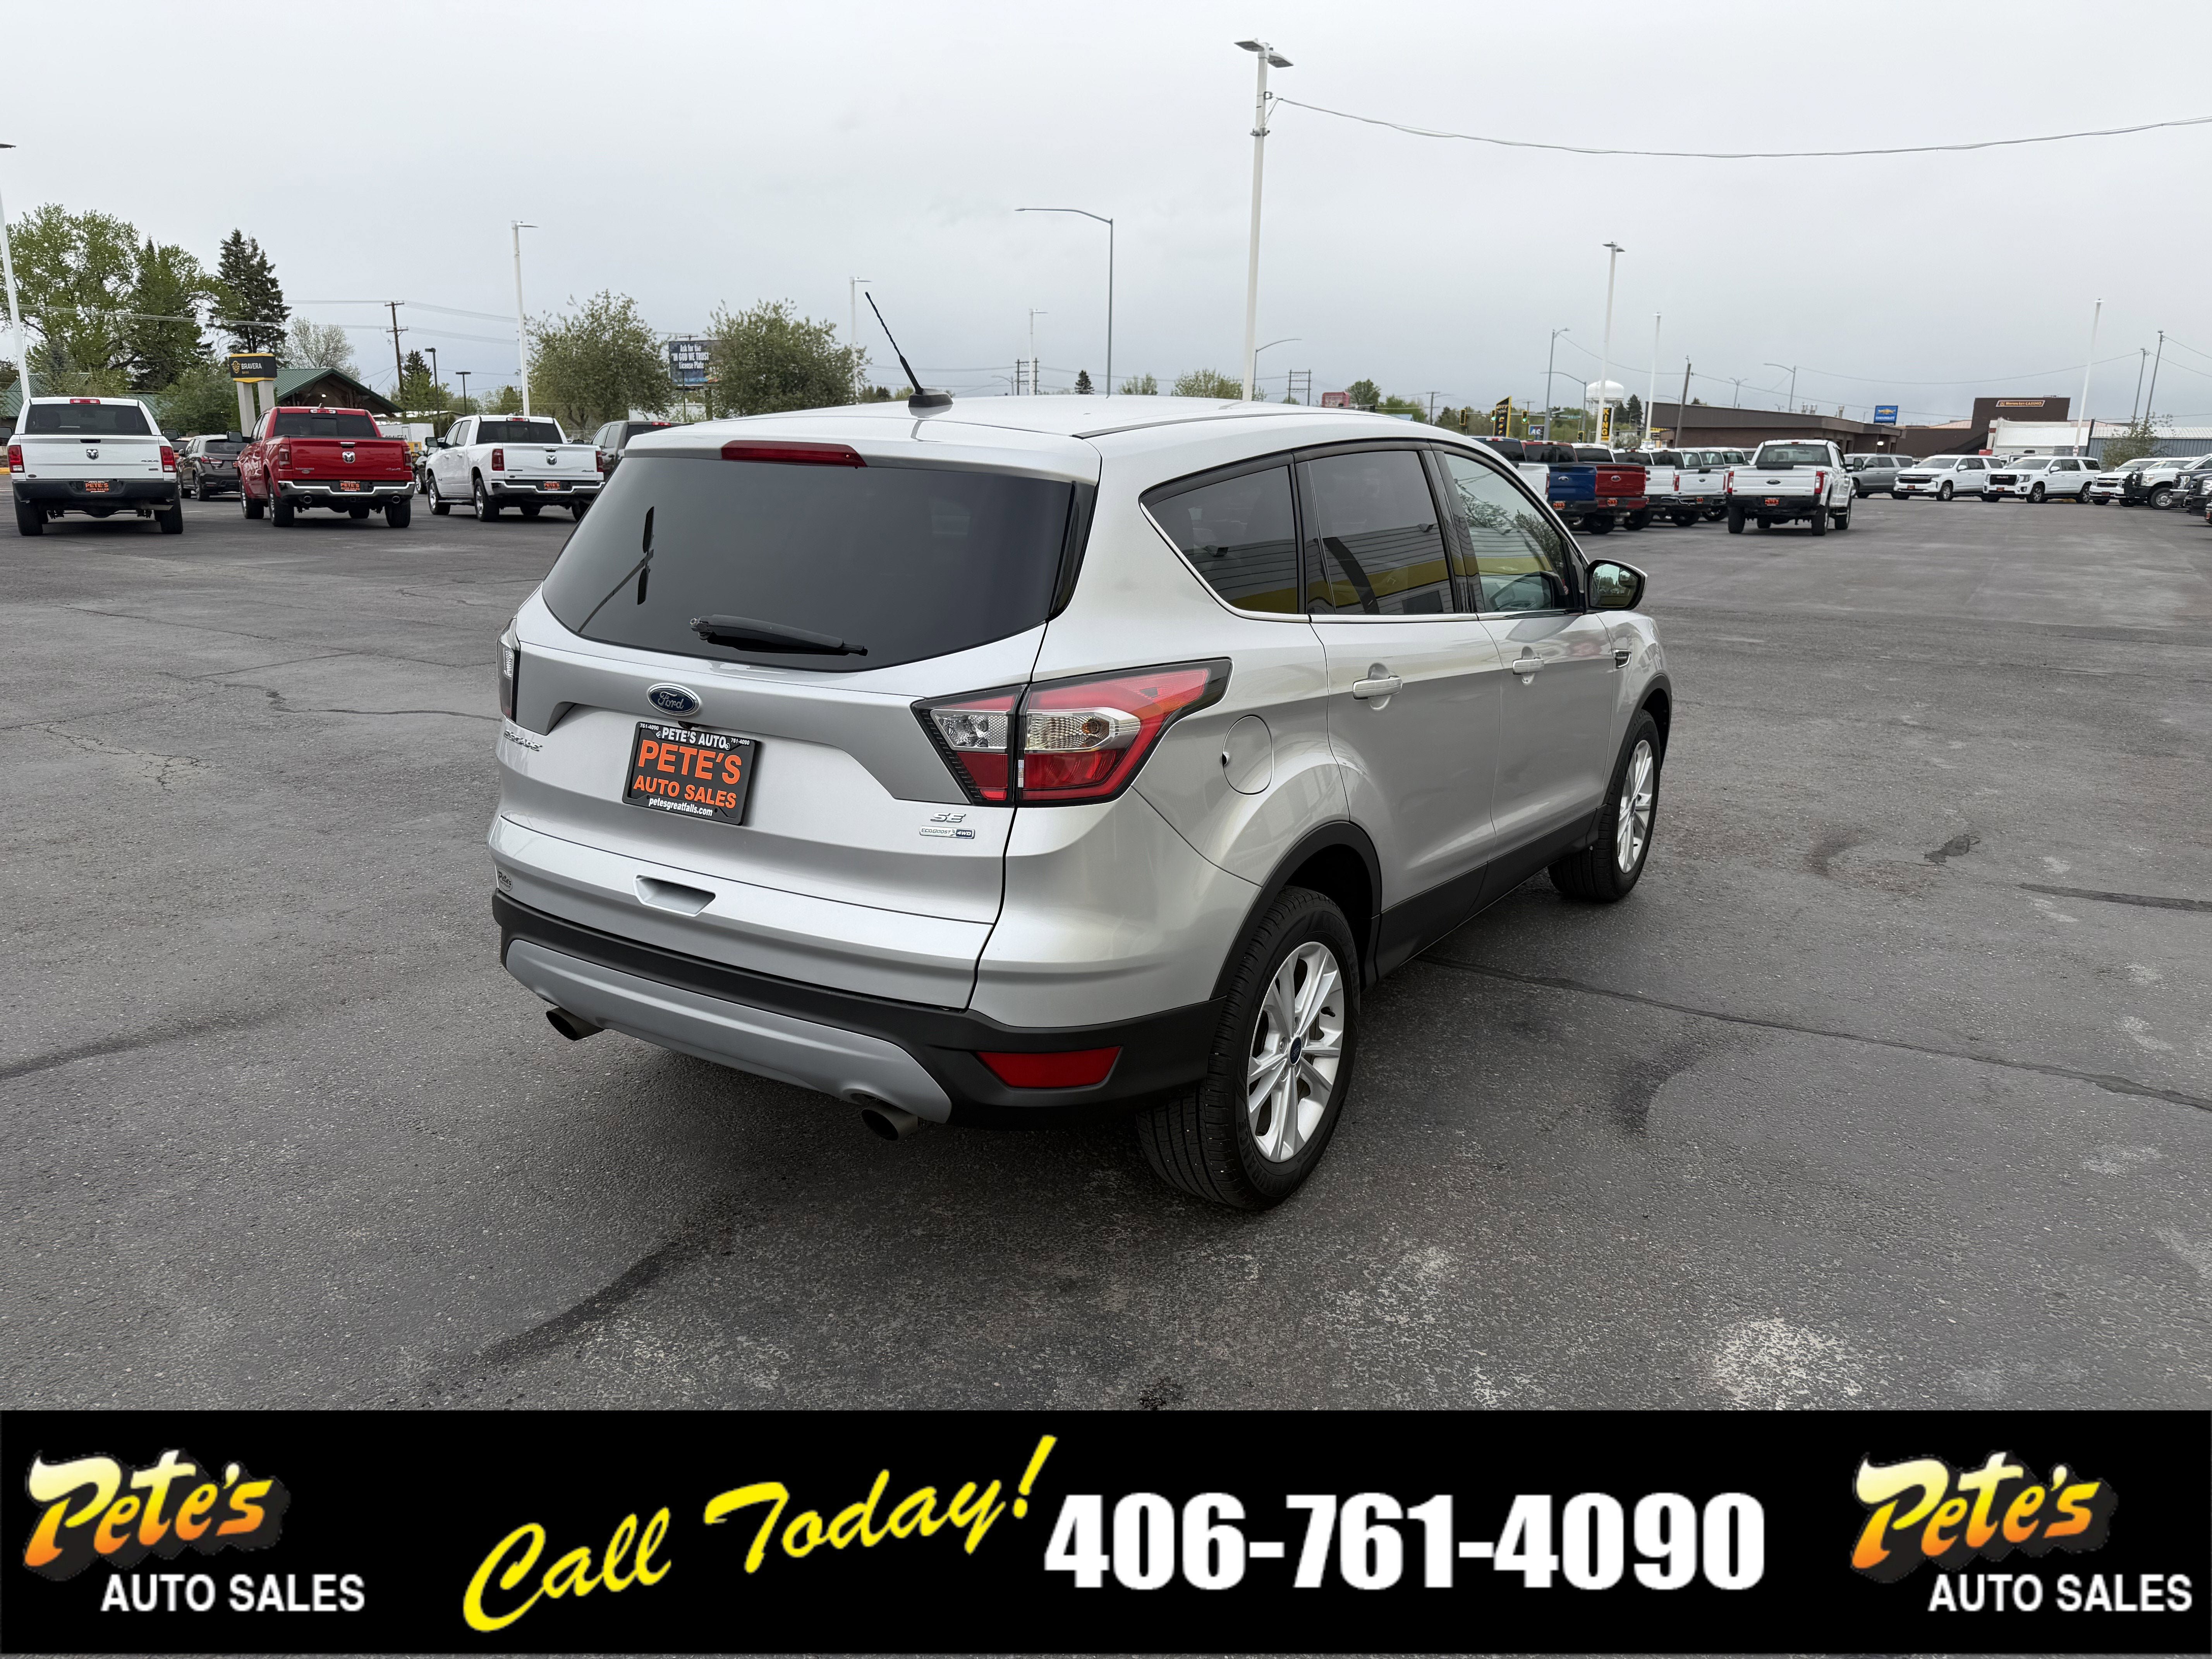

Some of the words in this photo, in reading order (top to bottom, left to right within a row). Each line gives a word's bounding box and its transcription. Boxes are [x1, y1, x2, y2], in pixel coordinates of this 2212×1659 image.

[658, 691, 684, 710] Ford
[661, 727, 697, 744] PETE'S
[698, 733, 726, 749] AUTO
[731, 737, 750, 745] 761-4090
[638, 739, 742, 785] PETE'S
[633, 775, 680, 797] AUTO
[684, 784, 737, 809] SALES
[649, 797, 713, 817] petesgreatfalls.com
[930, 812, 967, 823] SE
